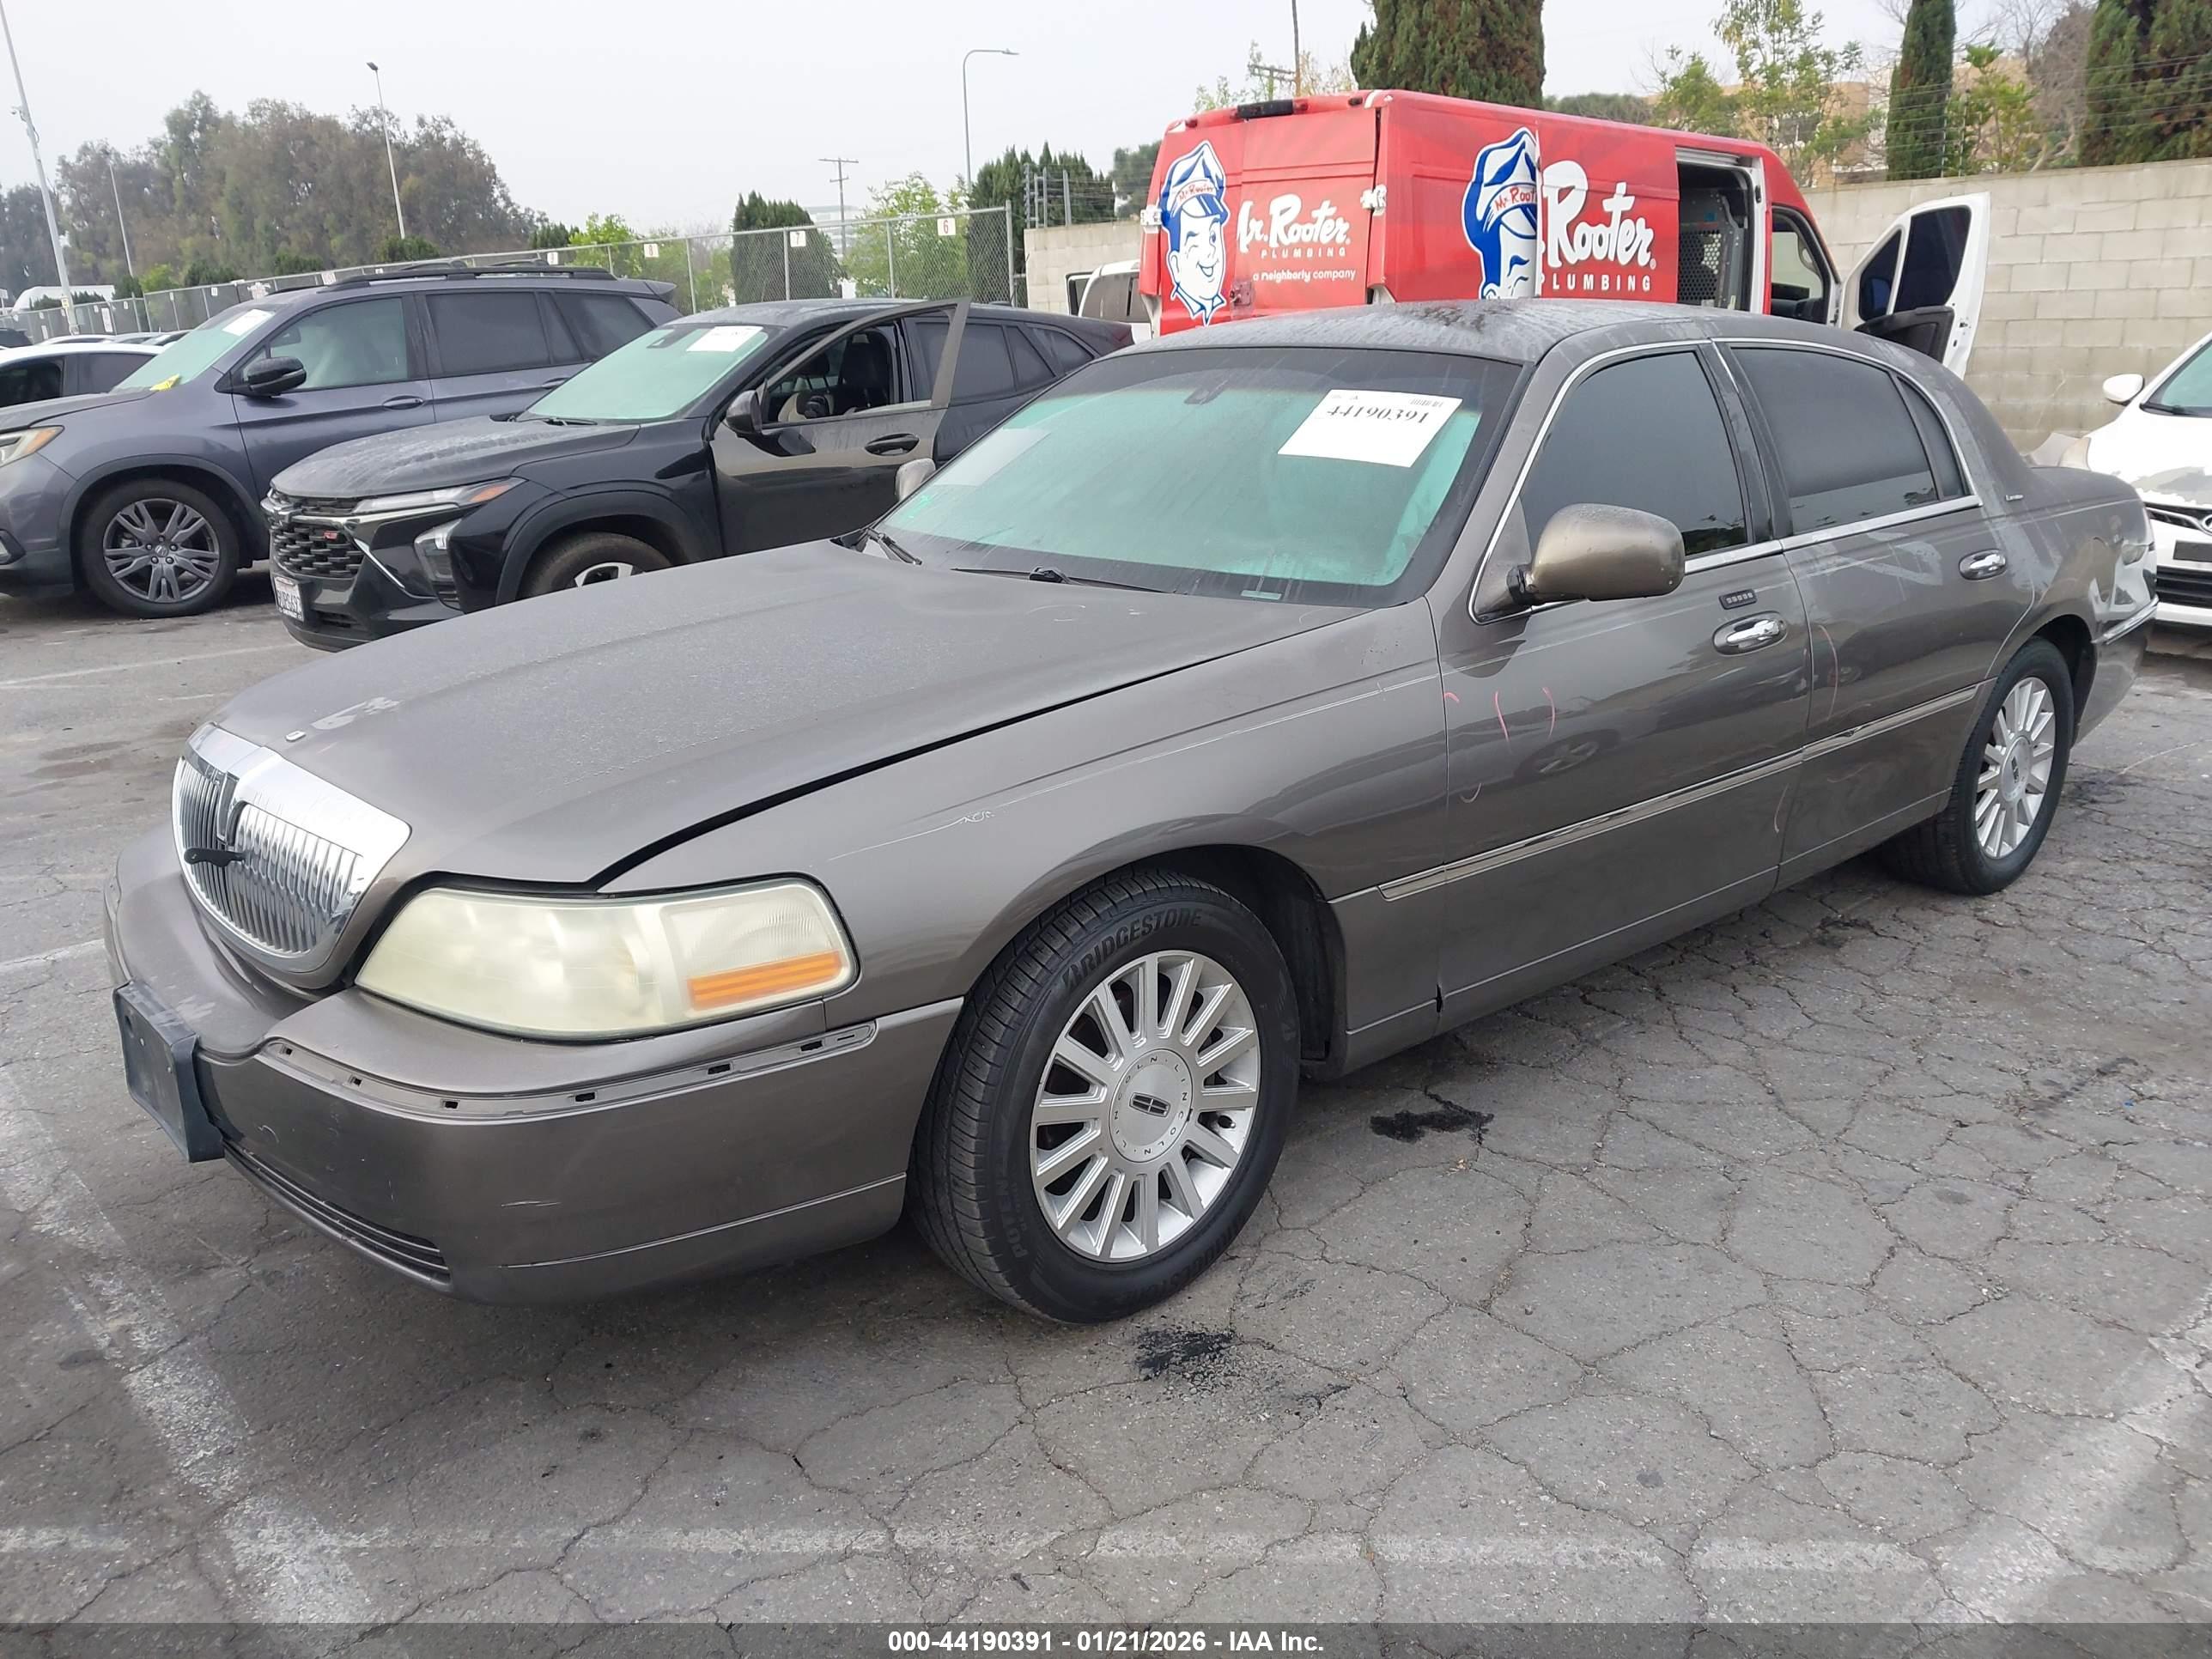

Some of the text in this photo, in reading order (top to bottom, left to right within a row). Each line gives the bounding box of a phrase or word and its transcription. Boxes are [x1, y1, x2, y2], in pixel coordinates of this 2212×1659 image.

[943, 219, 949, 234] 6
[1261, 247, 1346, 258] PLUMBING
[1253, 269, 1356, 283] a neighborly company
[1540, 272, 1650, 292] LUMBING
[1327, 404, 1430, 423] 44190391
[1061, 907, 1204, 986] BRIDGESTONE
